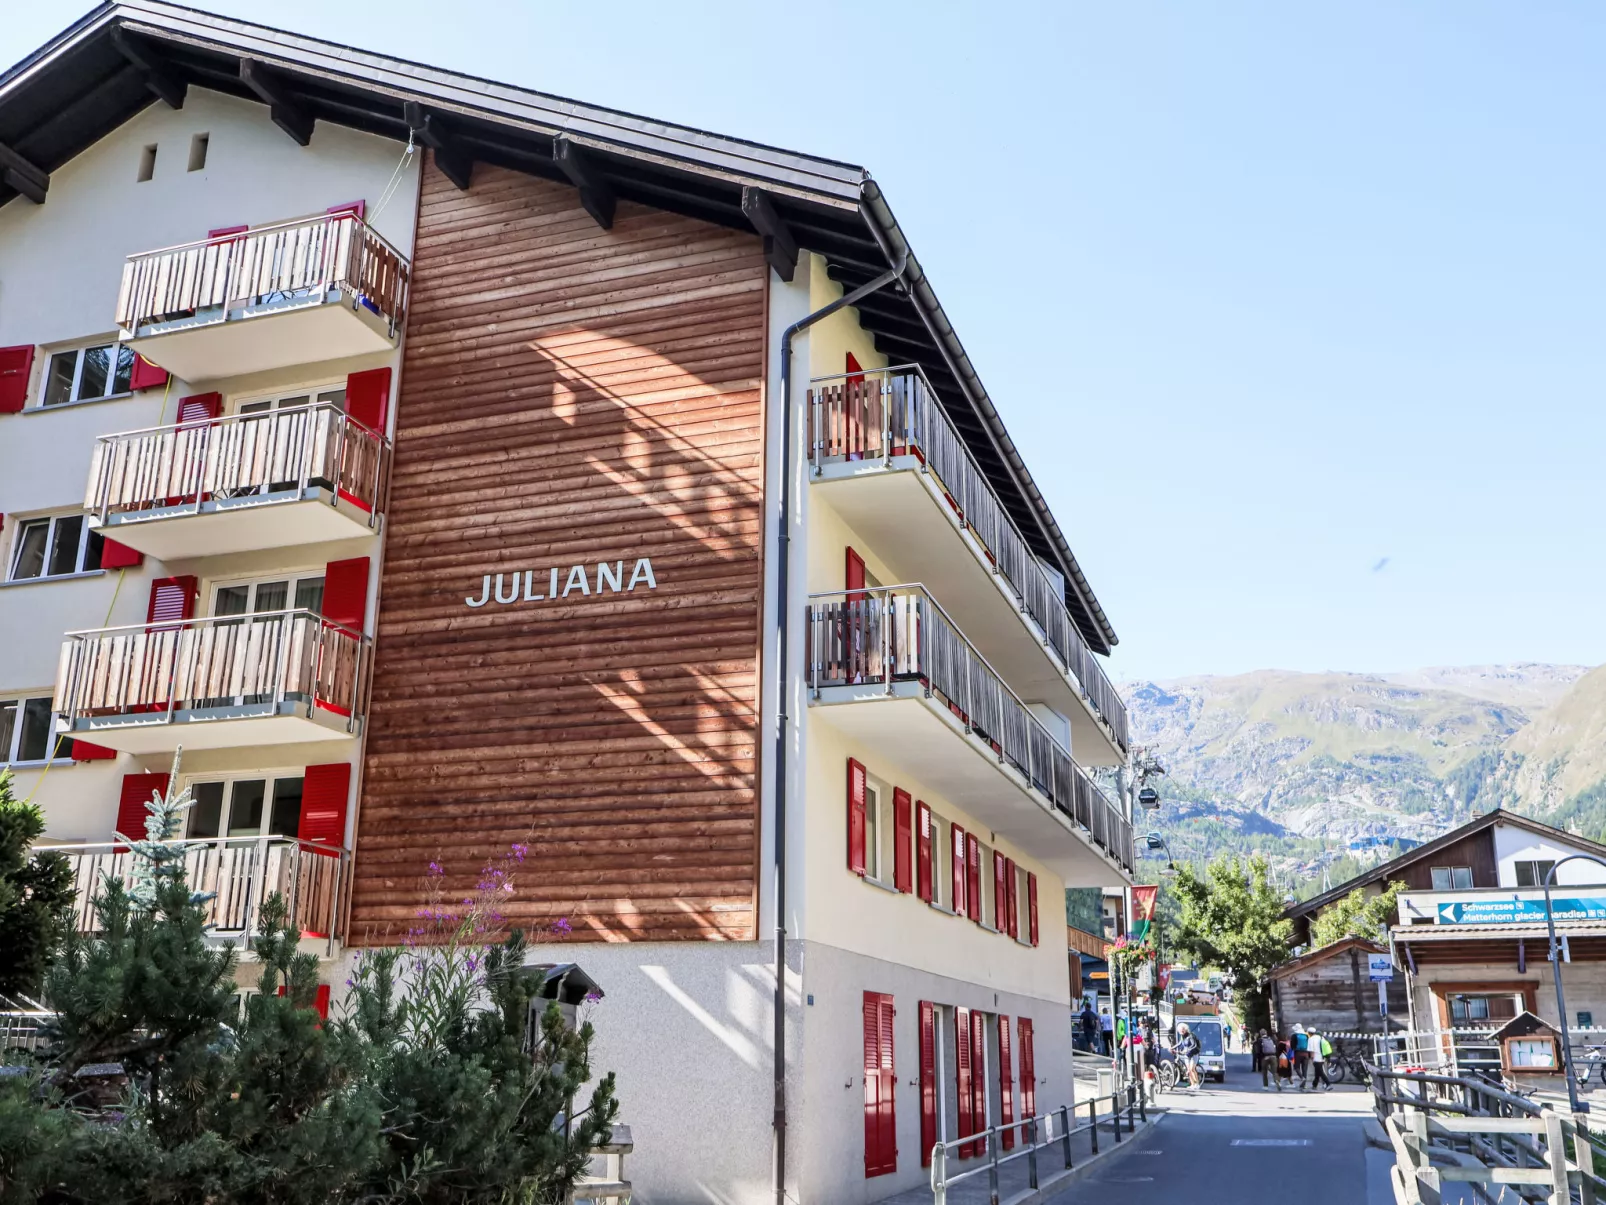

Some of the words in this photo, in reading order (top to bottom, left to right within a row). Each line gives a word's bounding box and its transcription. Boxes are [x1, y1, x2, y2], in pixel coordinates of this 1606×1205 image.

[465, 557, 657, 607] JULIANA
[1461, 903, 1515, 912] Schwarzsee
[1463, 912, 1513, 921] Matterhorn
[1514, 911, 1545, 921] glacier
